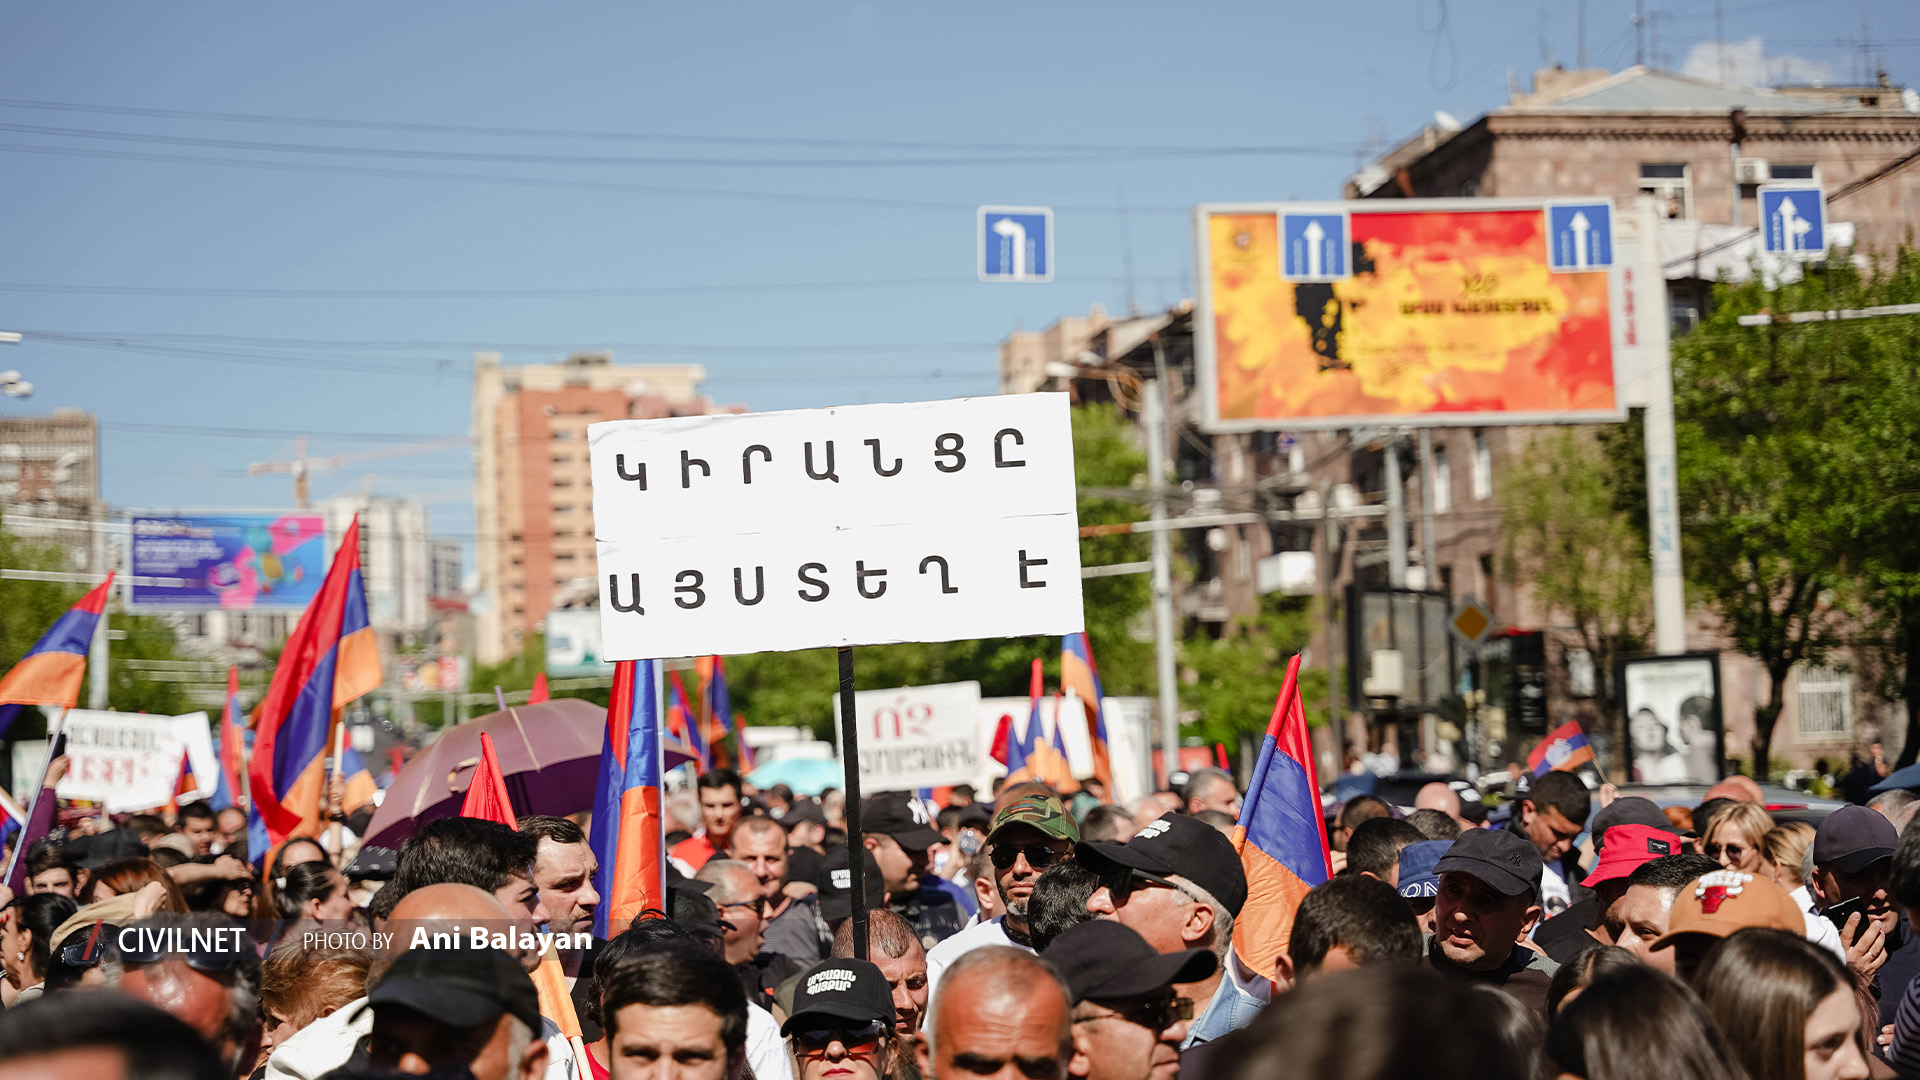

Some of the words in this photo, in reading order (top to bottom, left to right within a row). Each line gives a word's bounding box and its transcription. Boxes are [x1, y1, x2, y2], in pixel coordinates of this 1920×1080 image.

[616, 428, 1026, 491] ԿԻՐԱՆՑԸ
[610, 556, 959, 616] ԱՅՍՏԵՂ
[1019, 550, 1048, 589] Է
